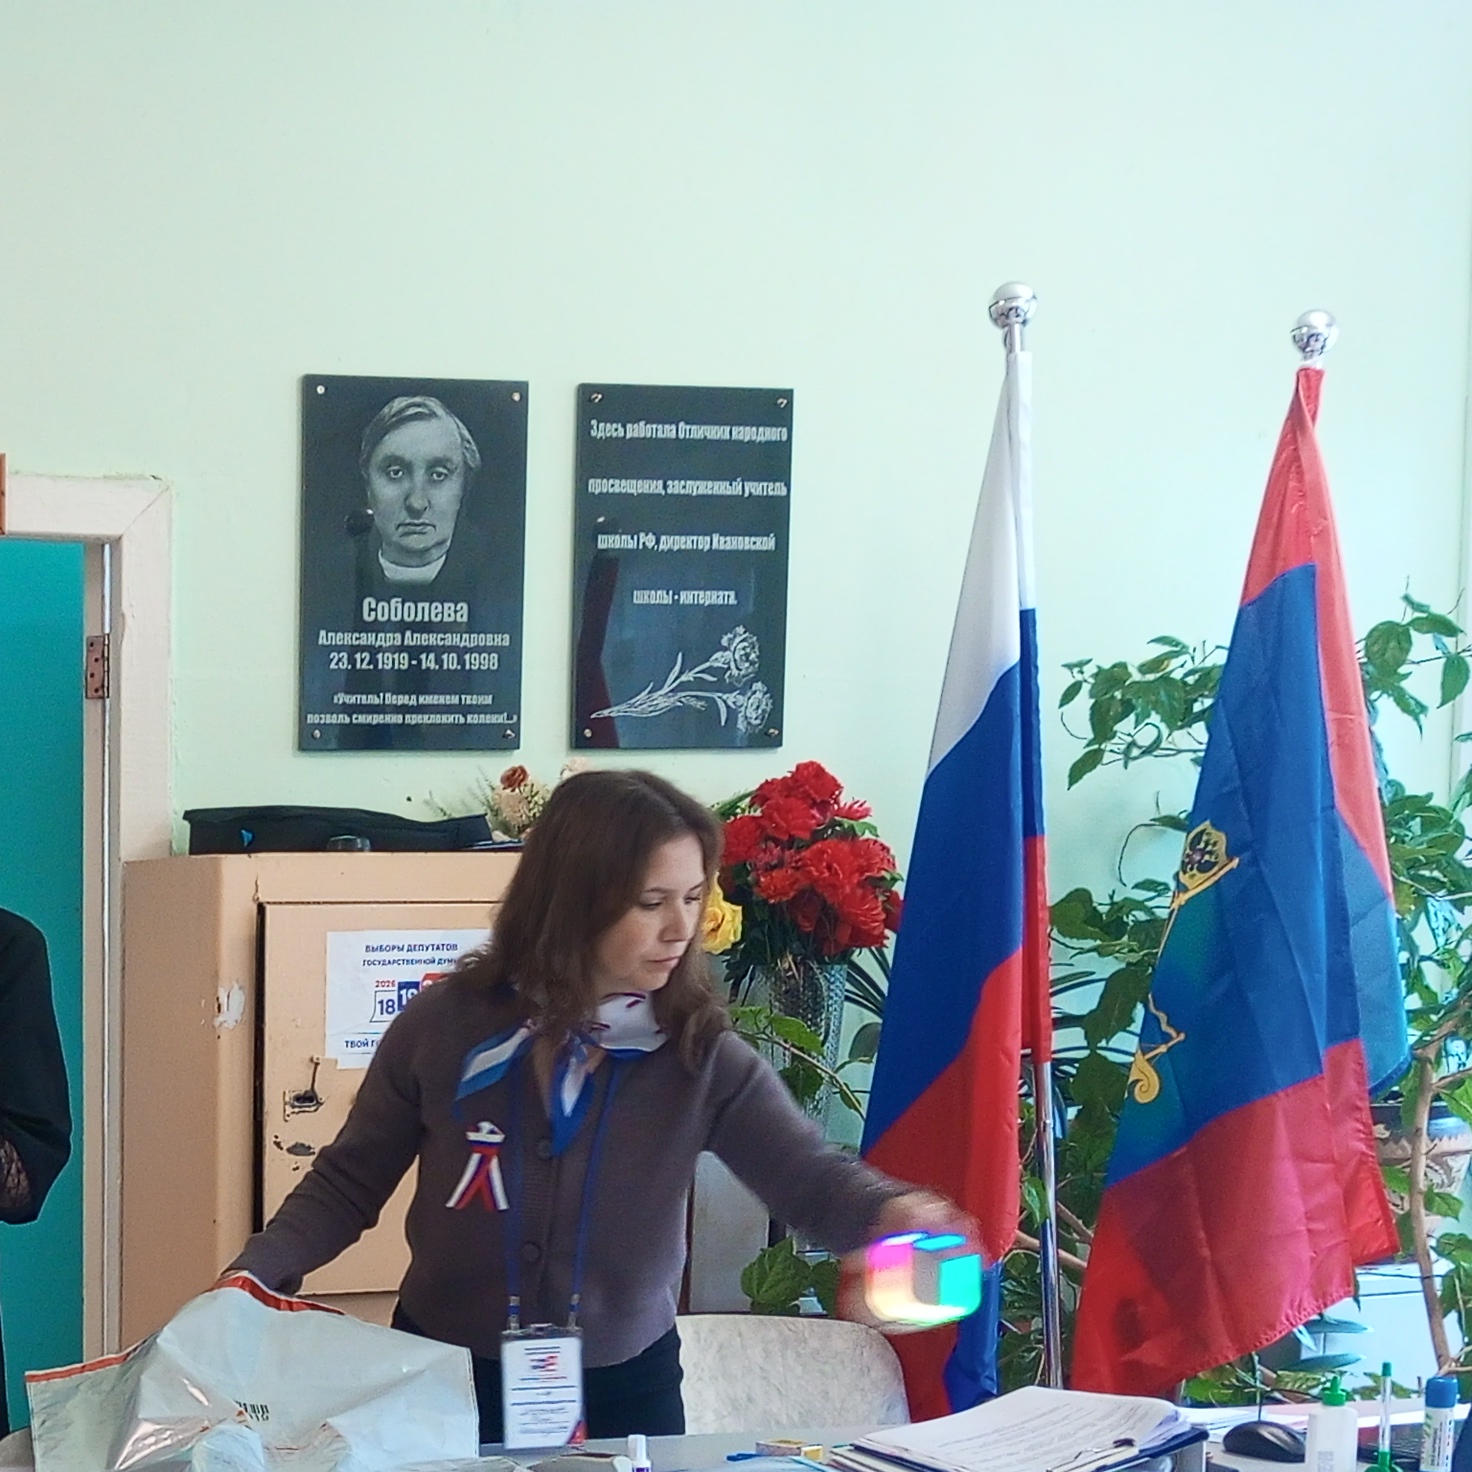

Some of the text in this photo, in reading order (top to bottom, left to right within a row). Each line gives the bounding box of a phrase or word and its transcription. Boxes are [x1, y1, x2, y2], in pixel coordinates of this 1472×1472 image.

[590, 419, 788, 442] Здесь работала Отличник народного
[588, 477, 788, 497] просвещения, заслуженный учитель
[597, 533, 637, 549] школы
[638, 531, 658, 551] РФ,
[658, 534, 710, 552] директор
[633, 589, 672, 604] школы
[679, 589, 738, 606] интерната.
[362, 597, 468, 622] Соболева
[318, 630, 510, 647] Александра Александровна
[329, 652, 352, 670] 23.
[354, 652, 374, 670] 12.
[376, 652, 409, 670] 1919
[420, 652, 439, 671] 14.
[441, 652, 462, 671] 10.
[464, 653, 498, 671] 1998
[385, 692, 417, 706] Перед
[418, 694, 459, 705] именем
[461, 694, 493, 705] твоим
[307, 712, 350, 724] позволь
[352, 713, 403, 725] смиренно
[405, 713, 465, 725] преклонить
[365, 943, 458, 953] ВЫБОРЫ ДЕПУТАТОВ
[362, 957, 436, 967] ГОСУДАРСТВЕННОЙ
[375, 980, 396, 988] 2026
[378, 998, 396, 1015] 18
[344, 1038, 370, 1048] ТВОЙ
